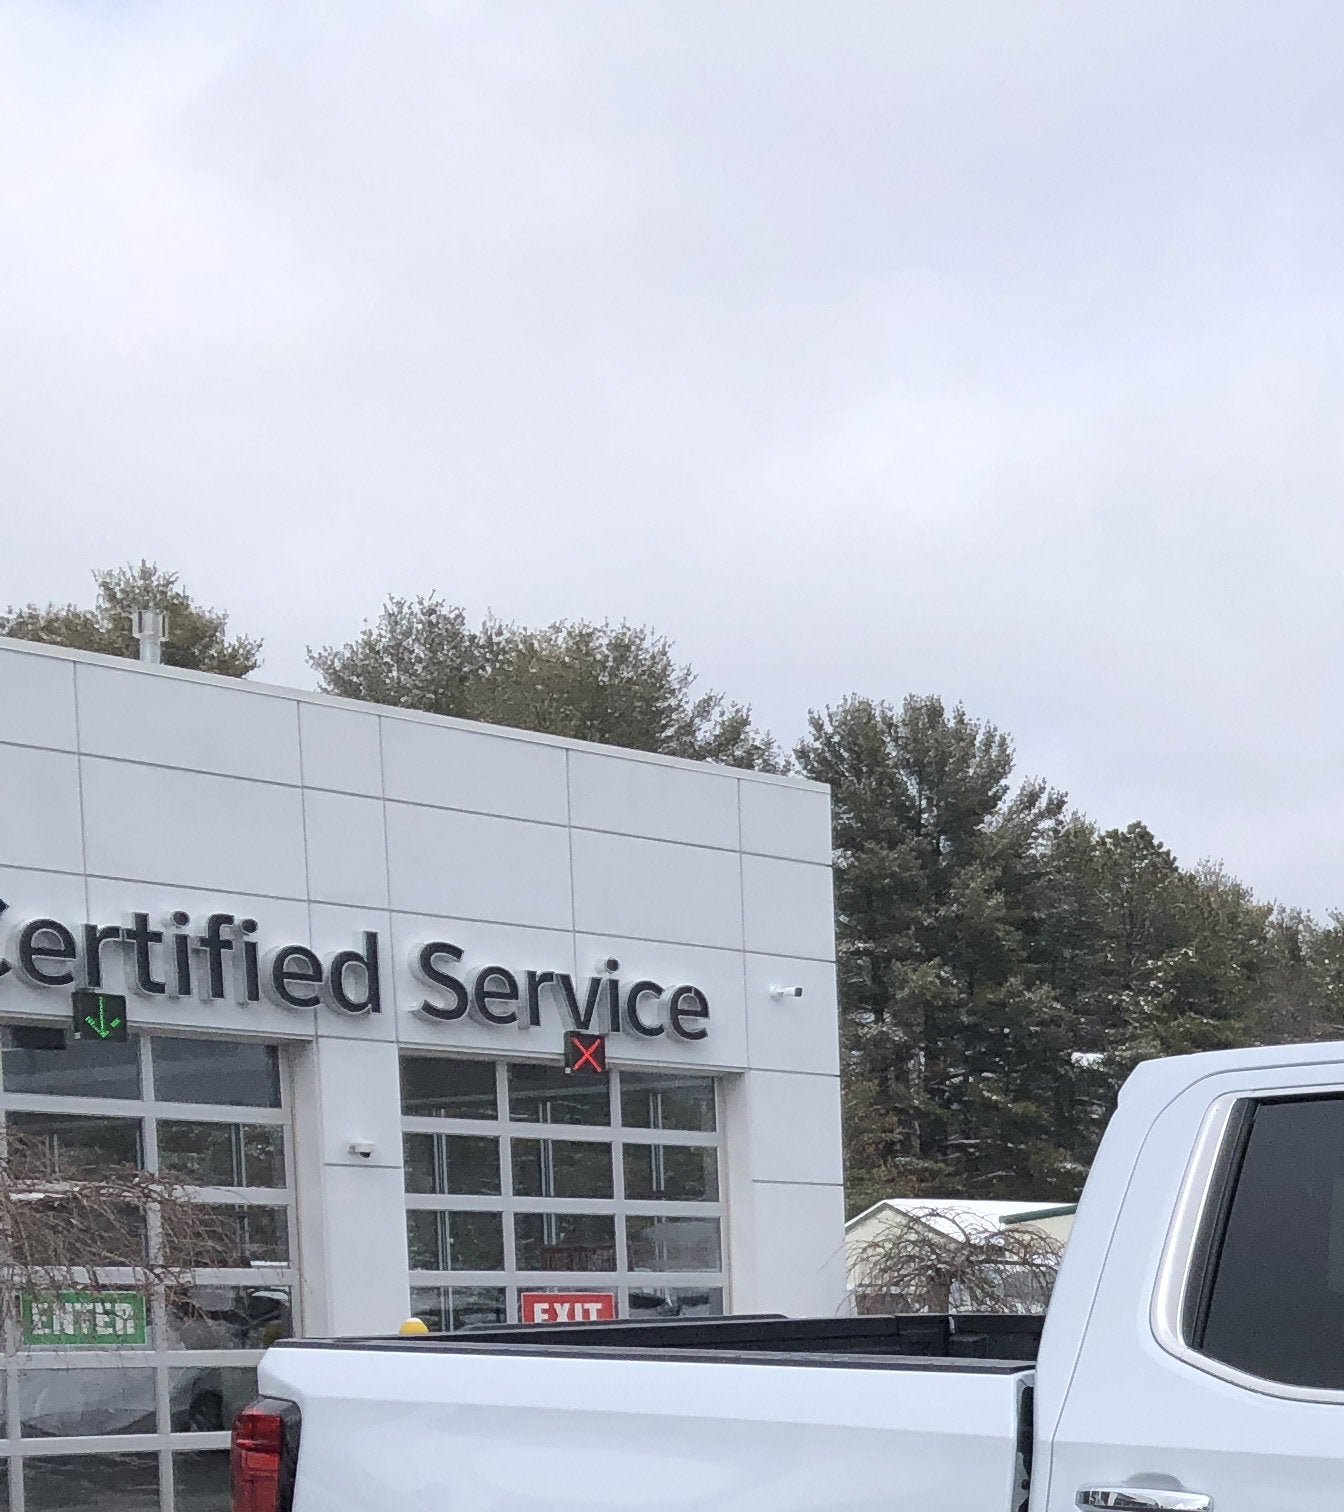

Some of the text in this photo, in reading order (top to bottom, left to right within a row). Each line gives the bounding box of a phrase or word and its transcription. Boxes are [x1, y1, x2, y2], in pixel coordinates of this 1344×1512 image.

[0, 898, 710, 1040] ertified Service
[31, 1302, 136, 1335] ENTER
[533, 1302, 603, 1324] EXIT
